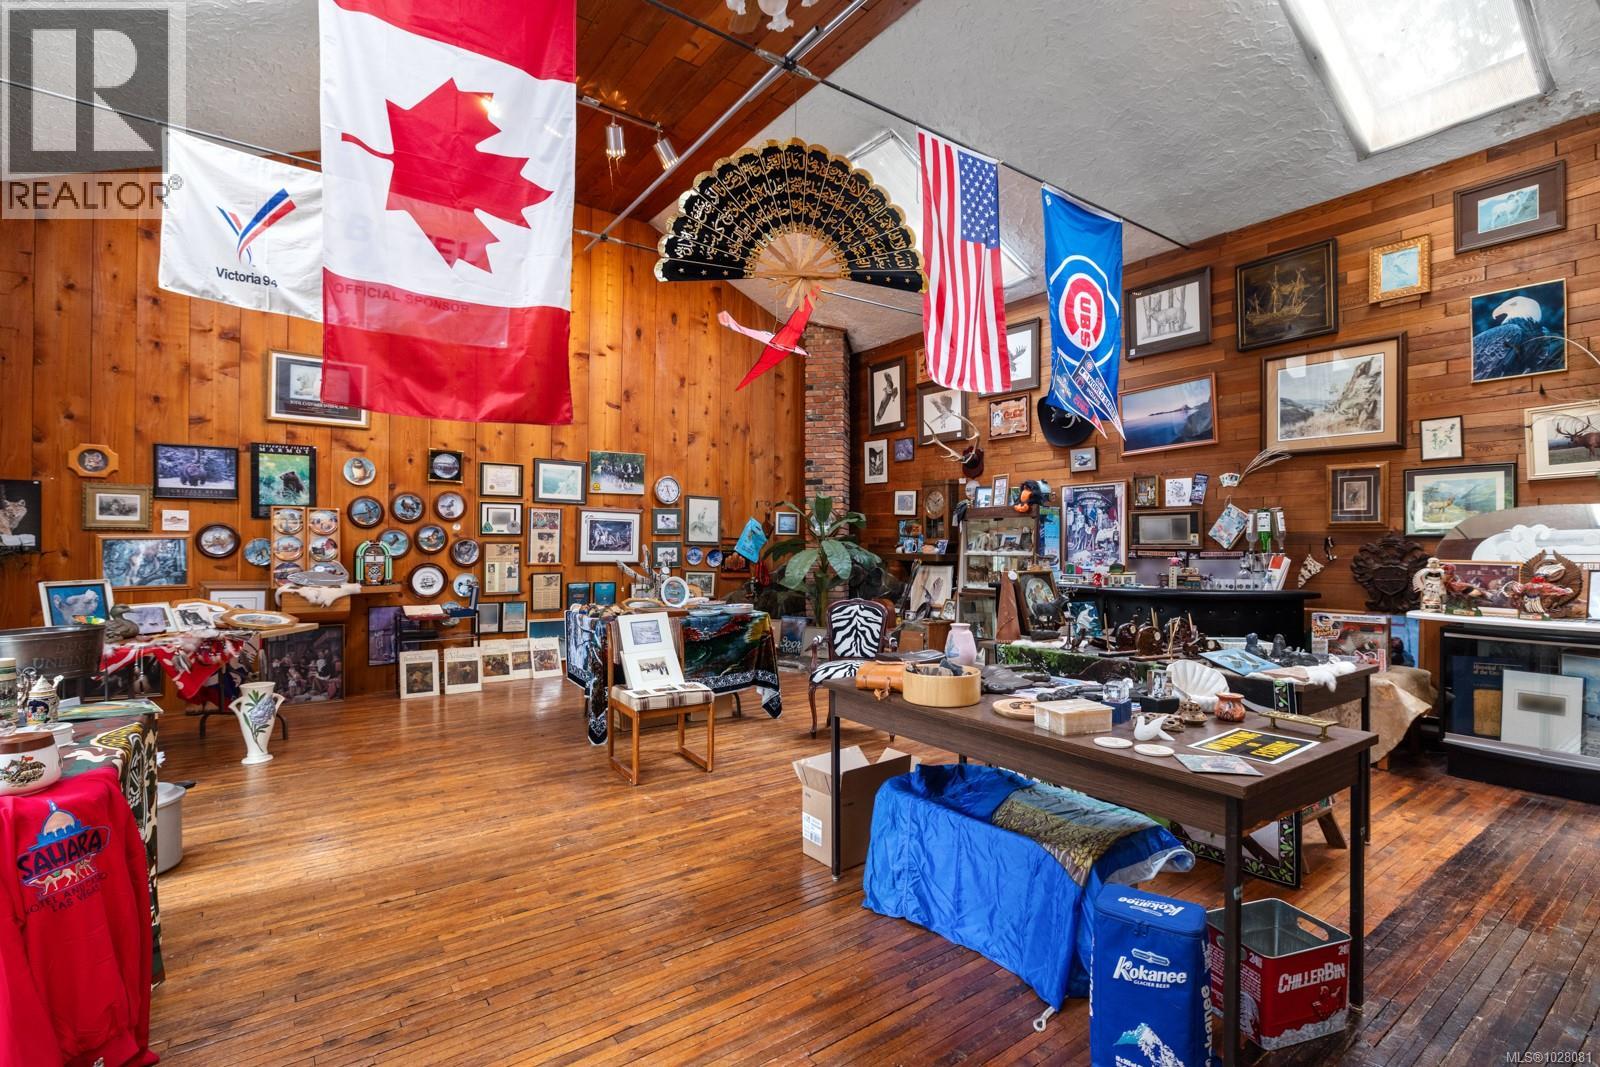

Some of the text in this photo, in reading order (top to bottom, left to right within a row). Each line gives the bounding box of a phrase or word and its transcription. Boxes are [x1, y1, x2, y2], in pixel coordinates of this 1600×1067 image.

[216, 266, 261, 285] Victoria
[333, 283, 470, 312] OFFICIAL SPONSOR
[258, 447, 310, 455] MARMOT
[16, 829, 102, 881] SAHARA
[1118, 896, 1184, 916] Kokanee
[1112, 955, 1188, 985] Kokanee
[1132, 979, 1155, 988] GLACIER
